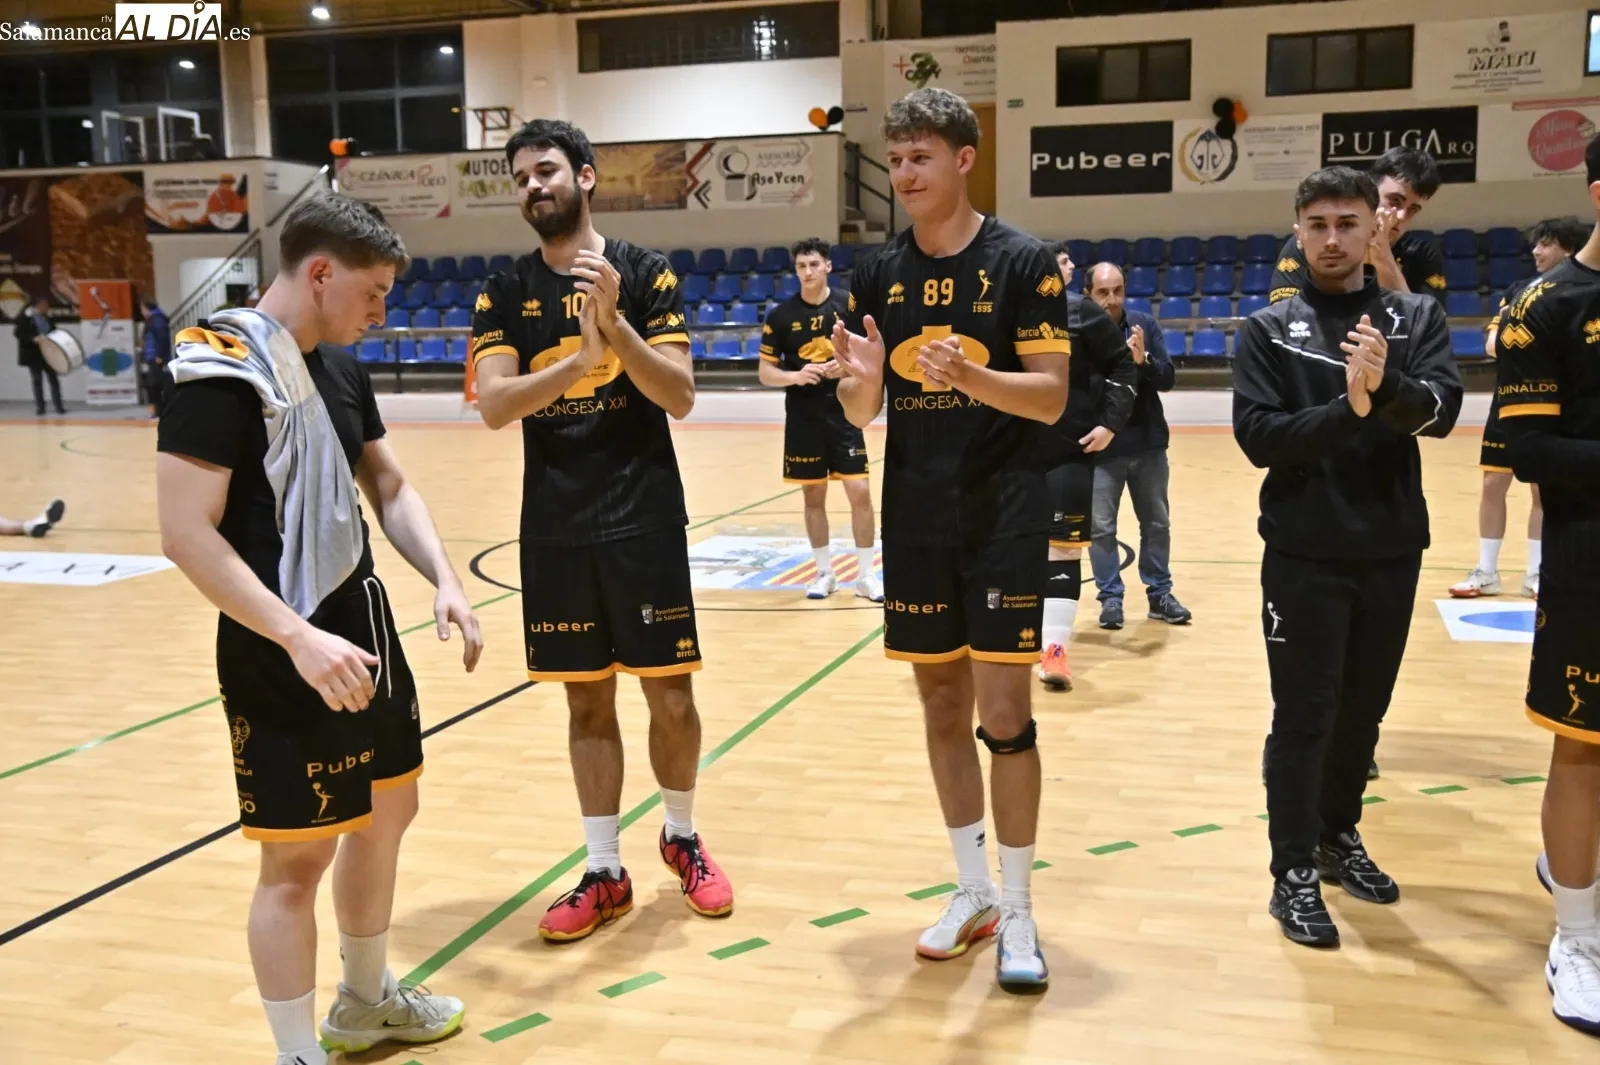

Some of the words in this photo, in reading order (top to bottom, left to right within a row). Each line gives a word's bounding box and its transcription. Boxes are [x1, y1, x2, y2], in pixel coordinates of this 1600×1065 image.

[461, 158, 508, 176] AUTOE
[1031, 150, 1171, 171] Pubeer
[922, 277, 955, 307] 89
[561, 292, 588, 319] 10
[810, 315, 824, 331] 27
[534, 400, 604, 418] CONGESA
[894, 393, 963, 412] CONGESA
[967, 395, 988, 408] XX
[885, 600, 948, 613] ubeer
[530, 621, 595, 633] ubeer
[1566, 664, 1600, 684] Pu
